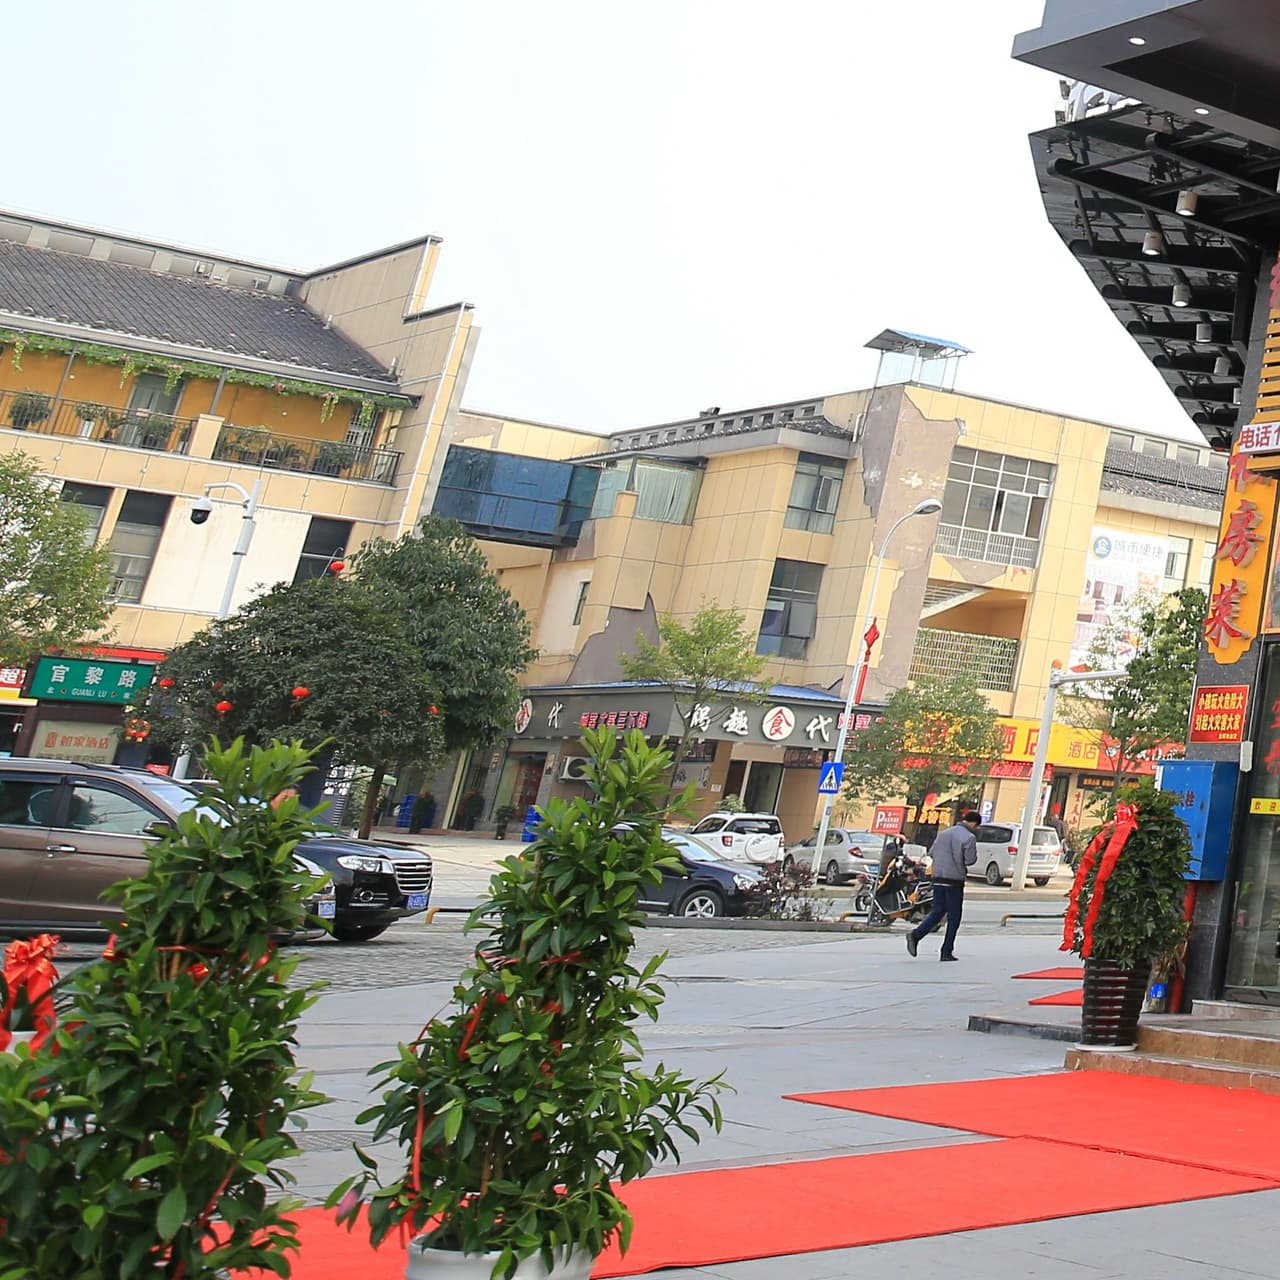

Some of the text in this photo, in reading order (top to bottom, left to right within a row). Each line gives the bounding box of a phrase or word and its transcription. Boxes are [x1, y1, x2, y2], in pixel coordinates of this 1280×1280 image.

[1240, 424, 1272, 449] 电话
[51, 665, 138, 688] 官黎路
